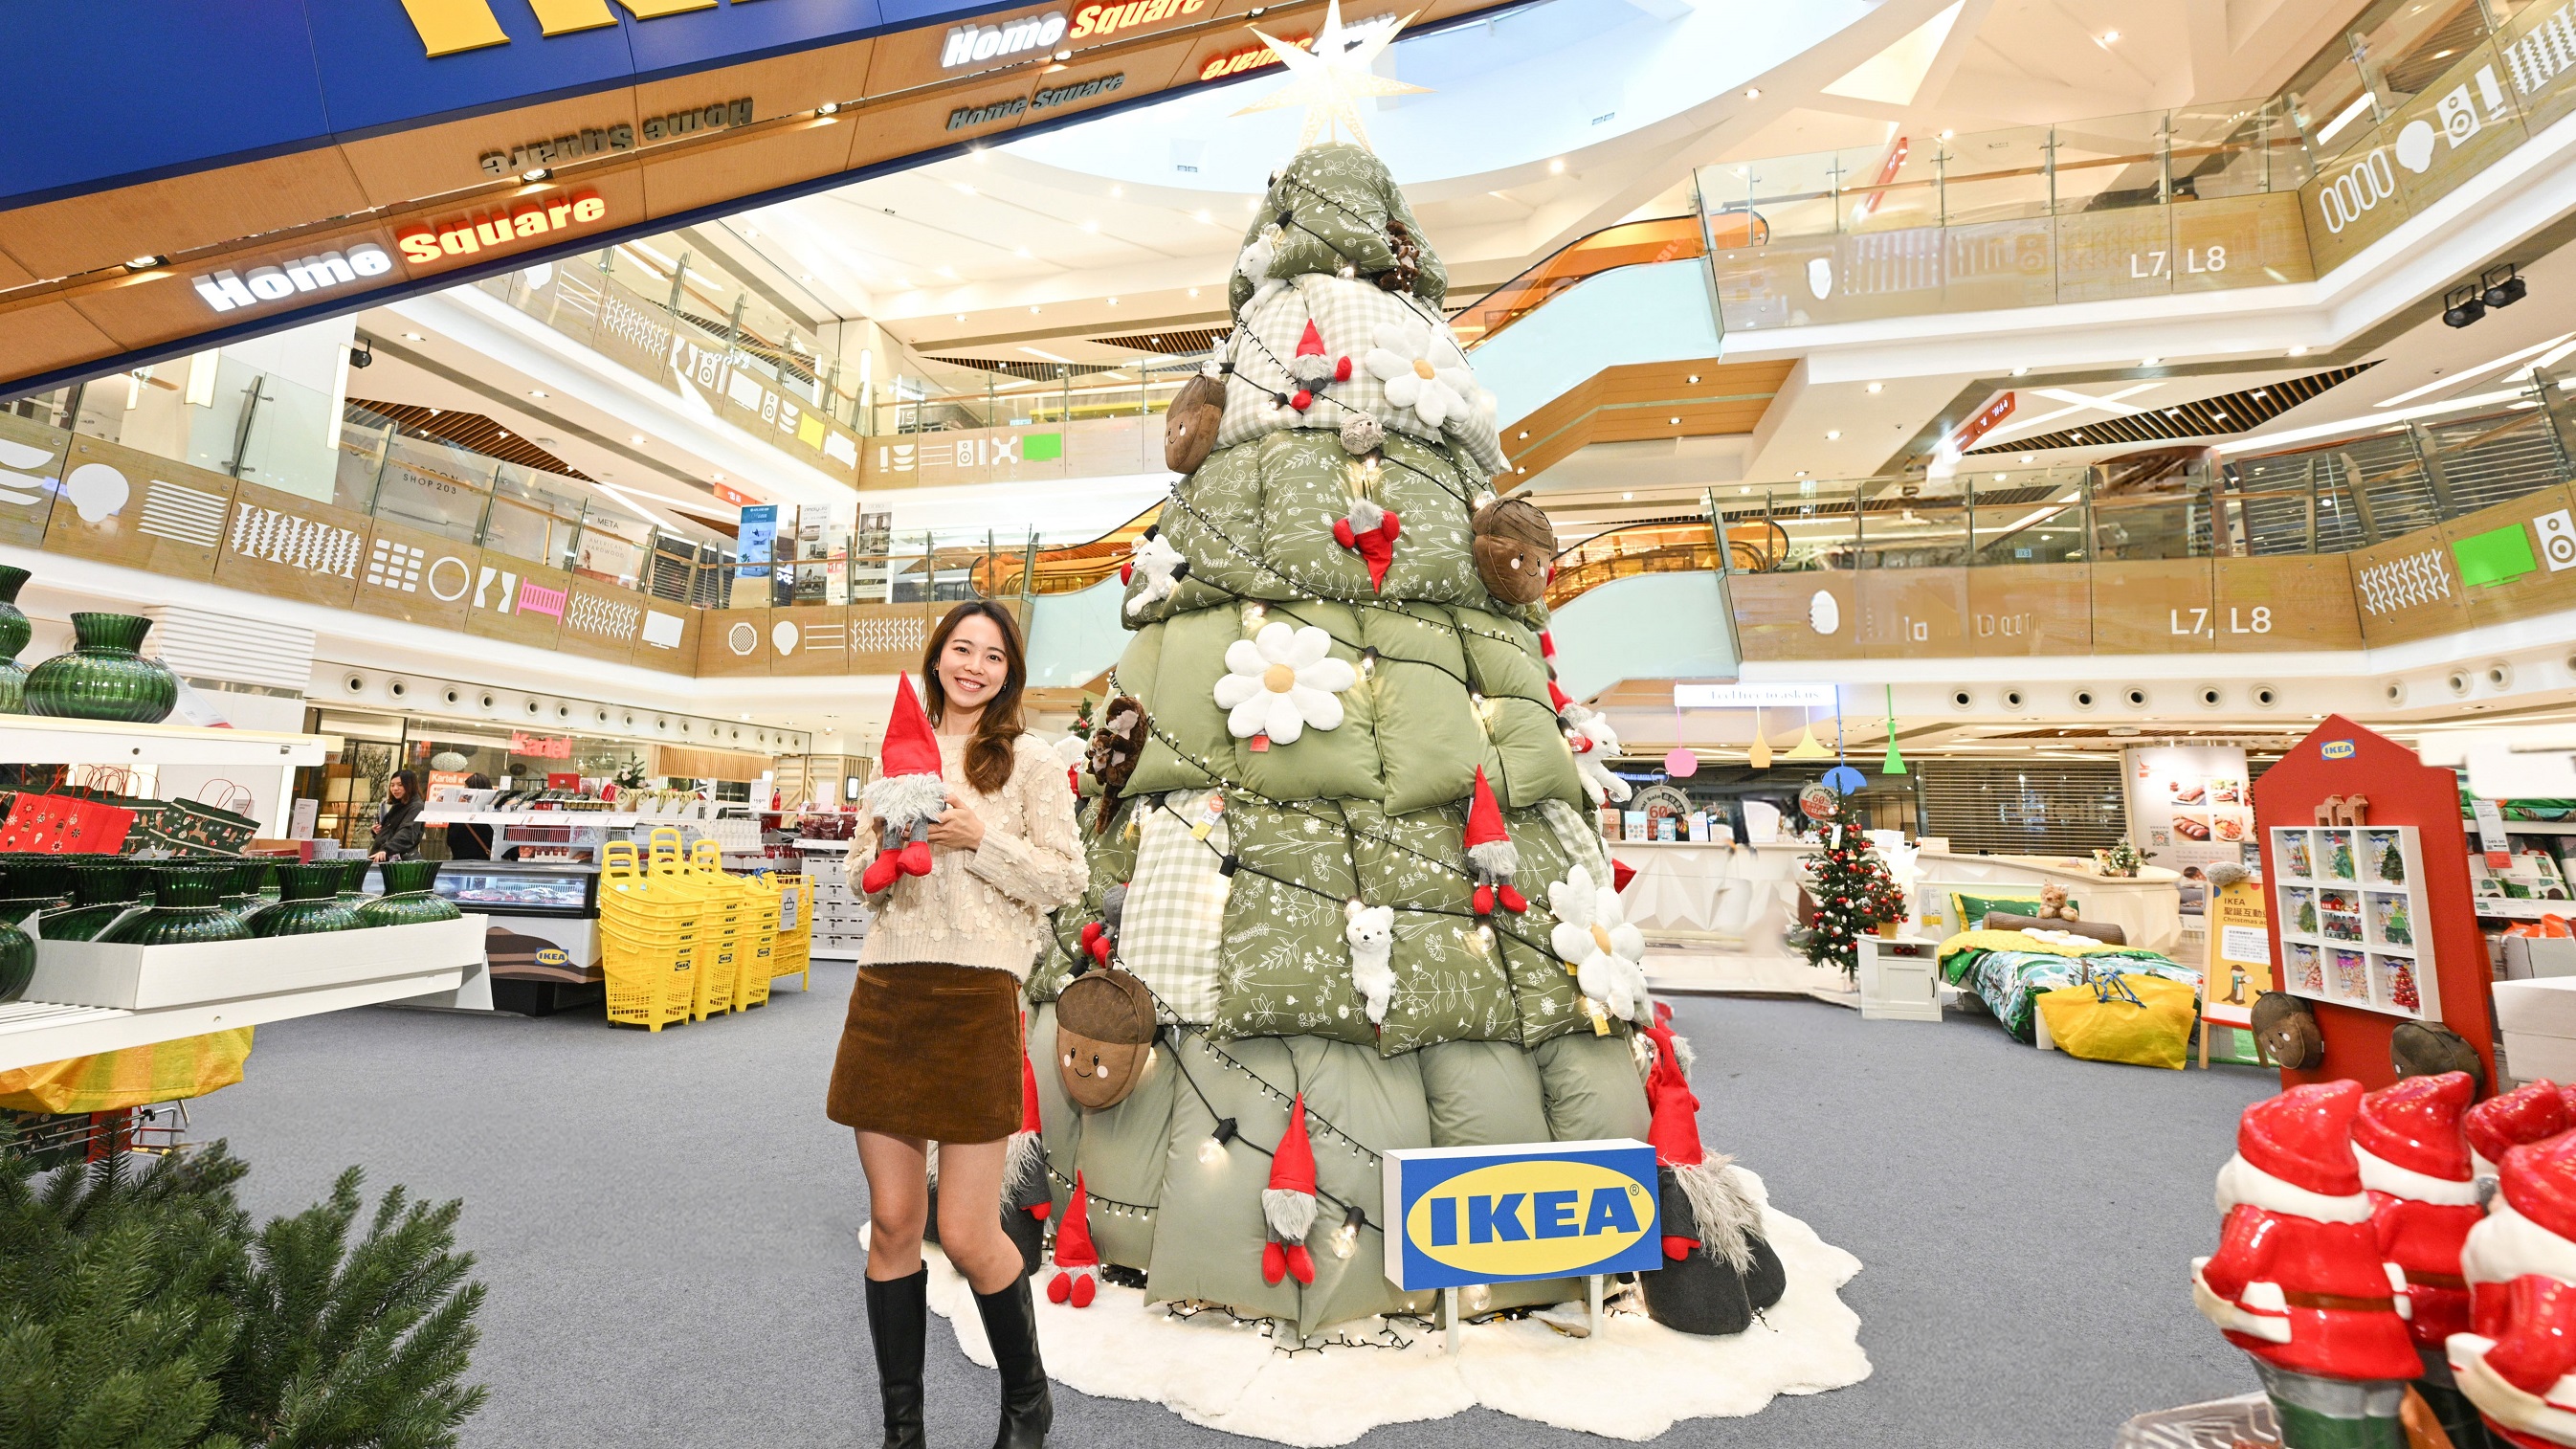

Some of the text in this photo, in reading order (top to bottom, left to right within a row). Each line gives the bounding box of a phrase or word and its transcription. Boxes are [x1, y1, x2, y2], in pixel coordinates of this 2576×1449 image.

[940, 11, 1067, 68] Home
[945, 72, 1125, 132] Home Square
[478, 97, 753, 178] Home Square
[192, 189, 606, 312] Home Square
[2187, 245, 2227, 274] L8
[404, 473, 457, 495] SHOP 203
[597, 517, 619, 530] META
[586, 544, 625, 559] HARDWOOD
[588, 537, 623, 551] AMERICAN
[2231, 606, 2272, 634] L8
[2324, 745, 2352, 754] IKEA
[2224, 897, 2246, 906] IKEA
[2223, 916, 2258, 925] Christmas
[539, 952, 566, 961] IKEA
[1431, 1185, 1641, 1247] IKEA
